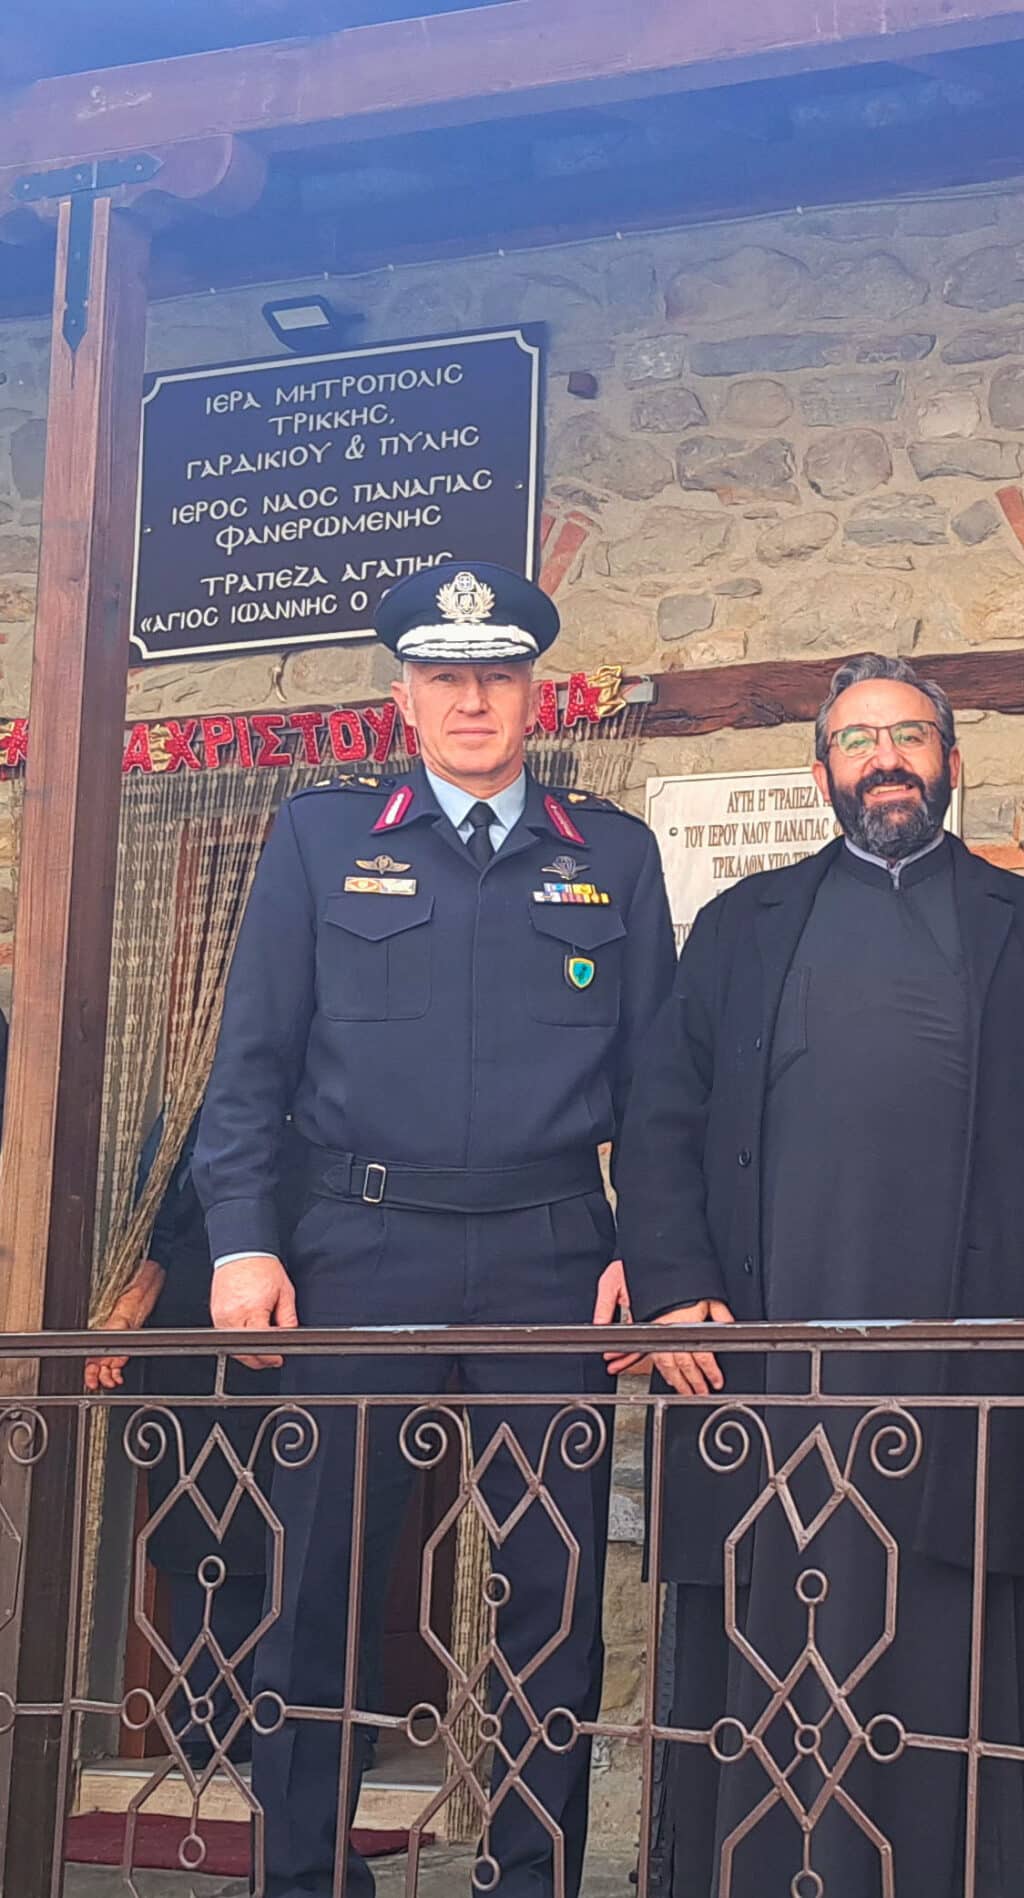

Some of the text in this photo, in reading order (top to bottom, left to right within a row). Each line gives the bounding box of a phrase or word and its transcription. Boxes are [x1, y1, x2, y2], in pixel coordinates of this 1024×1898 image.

[206, 390, 262, 415] ΙΕΡΑ
[186, 441, 332, 480] ΓΑΡΔΙΚΙΟΥ
[344, 433, 366, 460] &
[200, 565, 328, 597] ΤΡΑΠΕΖΑ
[350, 590, 369, 612] Ο
[726, 789, 755, 814] ΑΥΤΗ
[684, 824, 706, 849] ΤΟΥ
[707, 822, 739, 848] ΙΕΡΟΥ
[741, 820, 772, 846] ΝΑΟΥ
